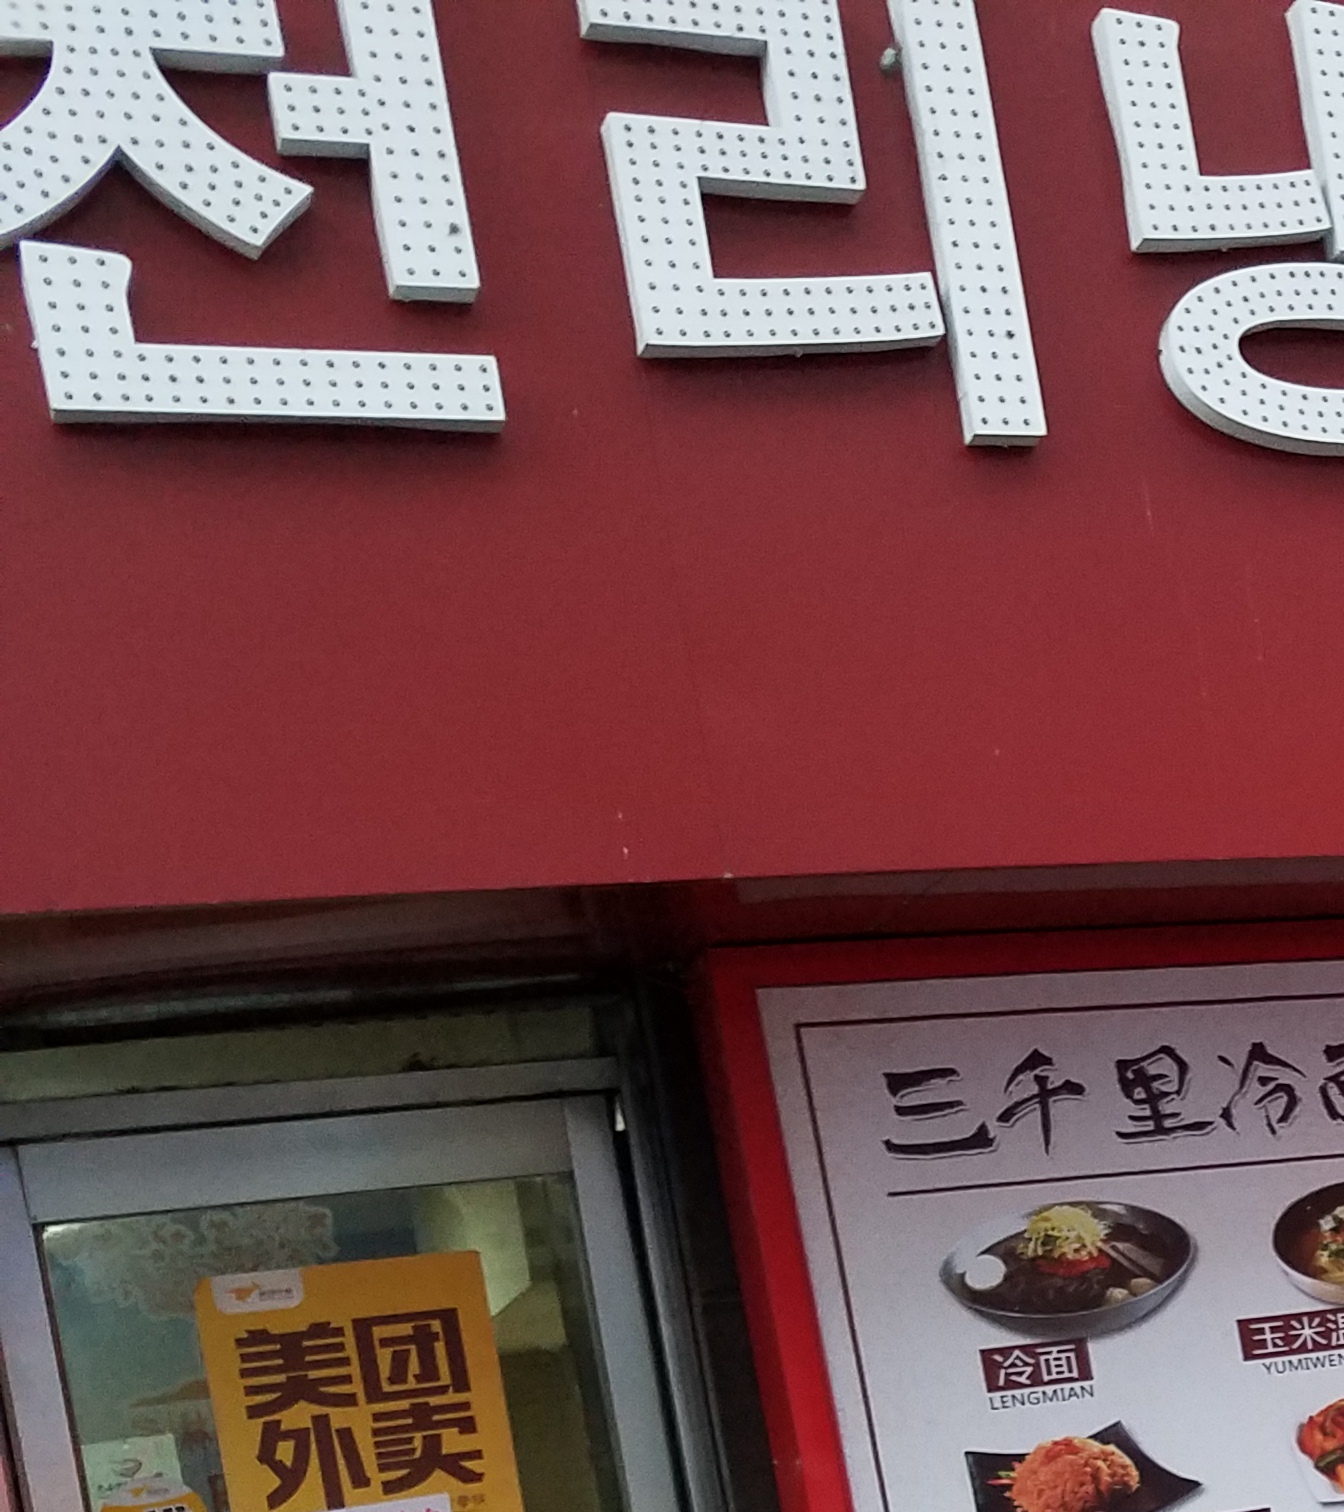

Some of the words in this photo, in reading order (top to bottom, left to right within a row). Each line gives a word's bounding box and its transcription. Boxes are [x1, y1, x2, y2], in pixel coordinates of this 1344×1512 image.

[234, 1307, 471, 1420] 美团
[989, 1385, 1095, 1411] LENGMIAN
[994, 1343, 1081, 1387] 冷面
[256, 1400, 486, 1510] 外卖
